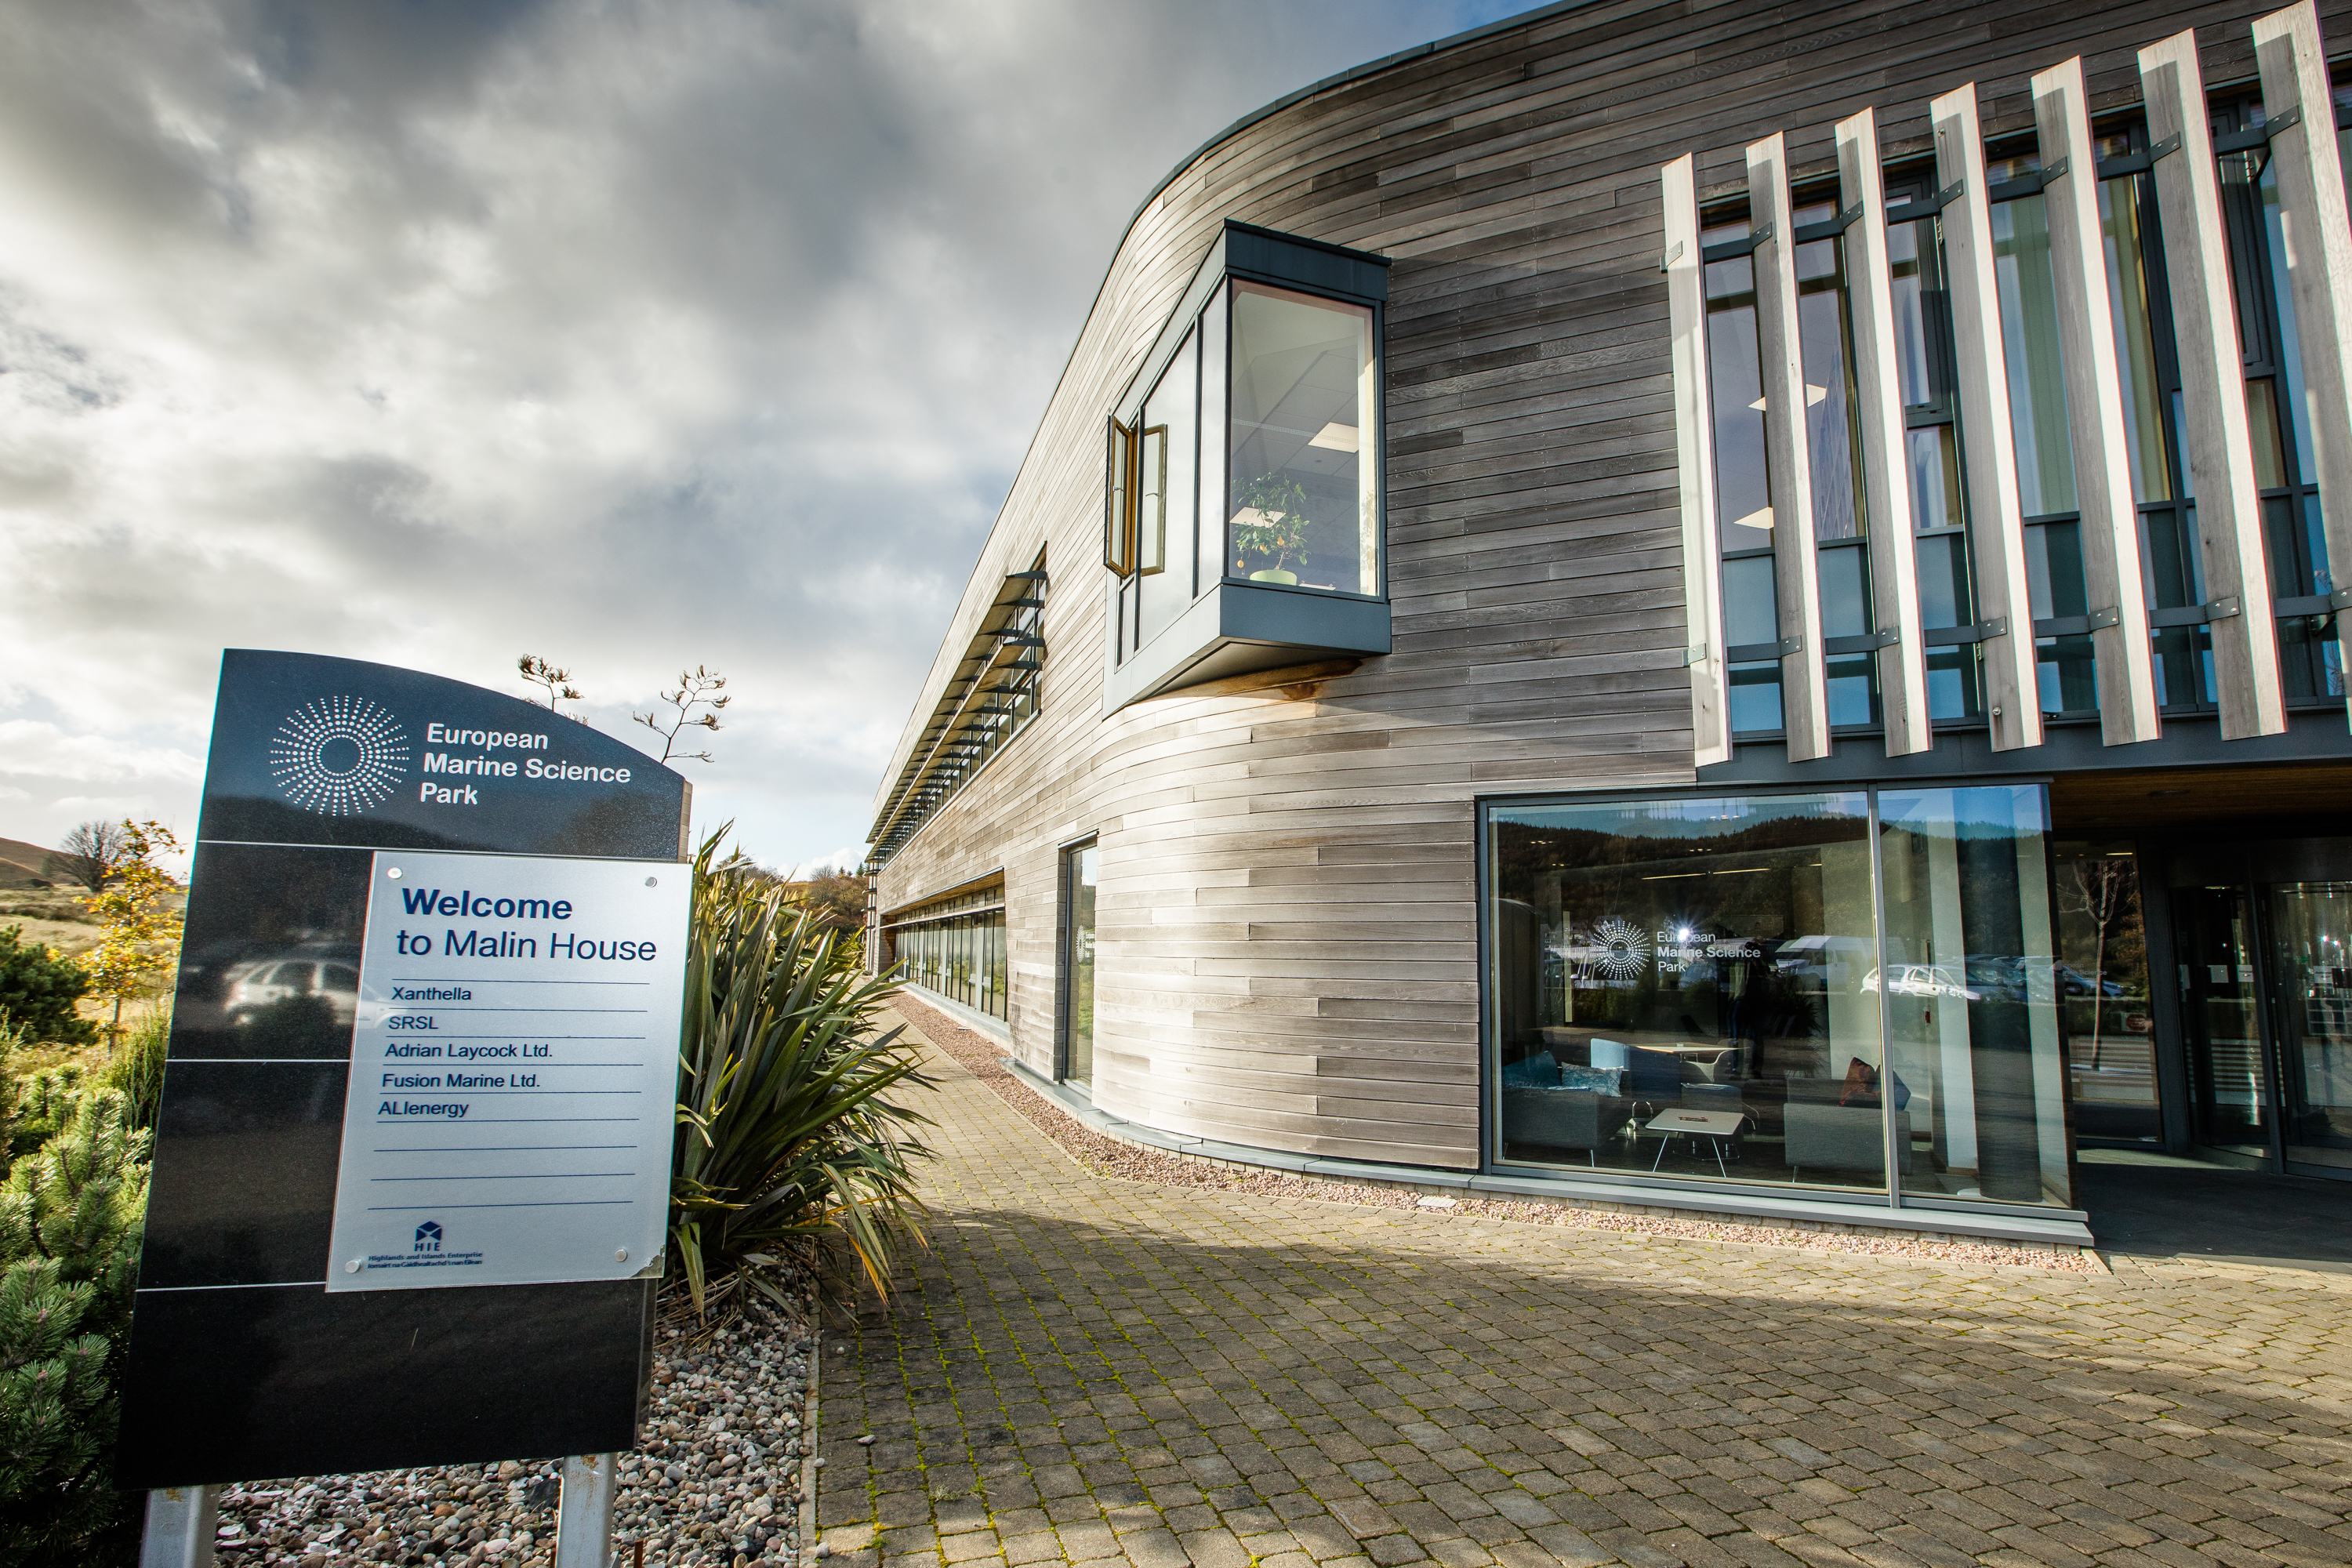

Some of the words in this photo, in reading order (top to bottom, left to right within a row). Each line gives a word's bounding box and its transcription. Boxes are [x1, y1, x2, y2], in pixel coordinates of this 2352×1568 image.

[426, 722, 549, 751] European
[423, 752, 518, 777] Marine
[524, 757, 631, 783] Science
[419, 782, 478, 805] Park
[401, 887, 573, 920] Welcome
[396, 930, 431, 956] to
[445, 929, 537, 958] Malin
[550, 932, 657, 961] House
[1657, 946, 1703, 957] Marine
[1707, 946, 1761, 958] Science
[1658, 961, 1686, 972] Park
[391, 986, 472, 1000] Xanthella
[388, 1016, 439, 1029] SRSL
[384, 1044, 441, 1057] Adrian
[447, 1044, 517, 1061] Laycock
[522, 1044, 553, 1058] Ltd.
[382, 1073, 441, 1087] Fusion
[446, 1073, 505, 1087] Marine
[510, 1073, 540, 1087] Ltd.
[414, 1242, 441, 1252] HIE
[368, 1254, 405, 1263] Highlands
